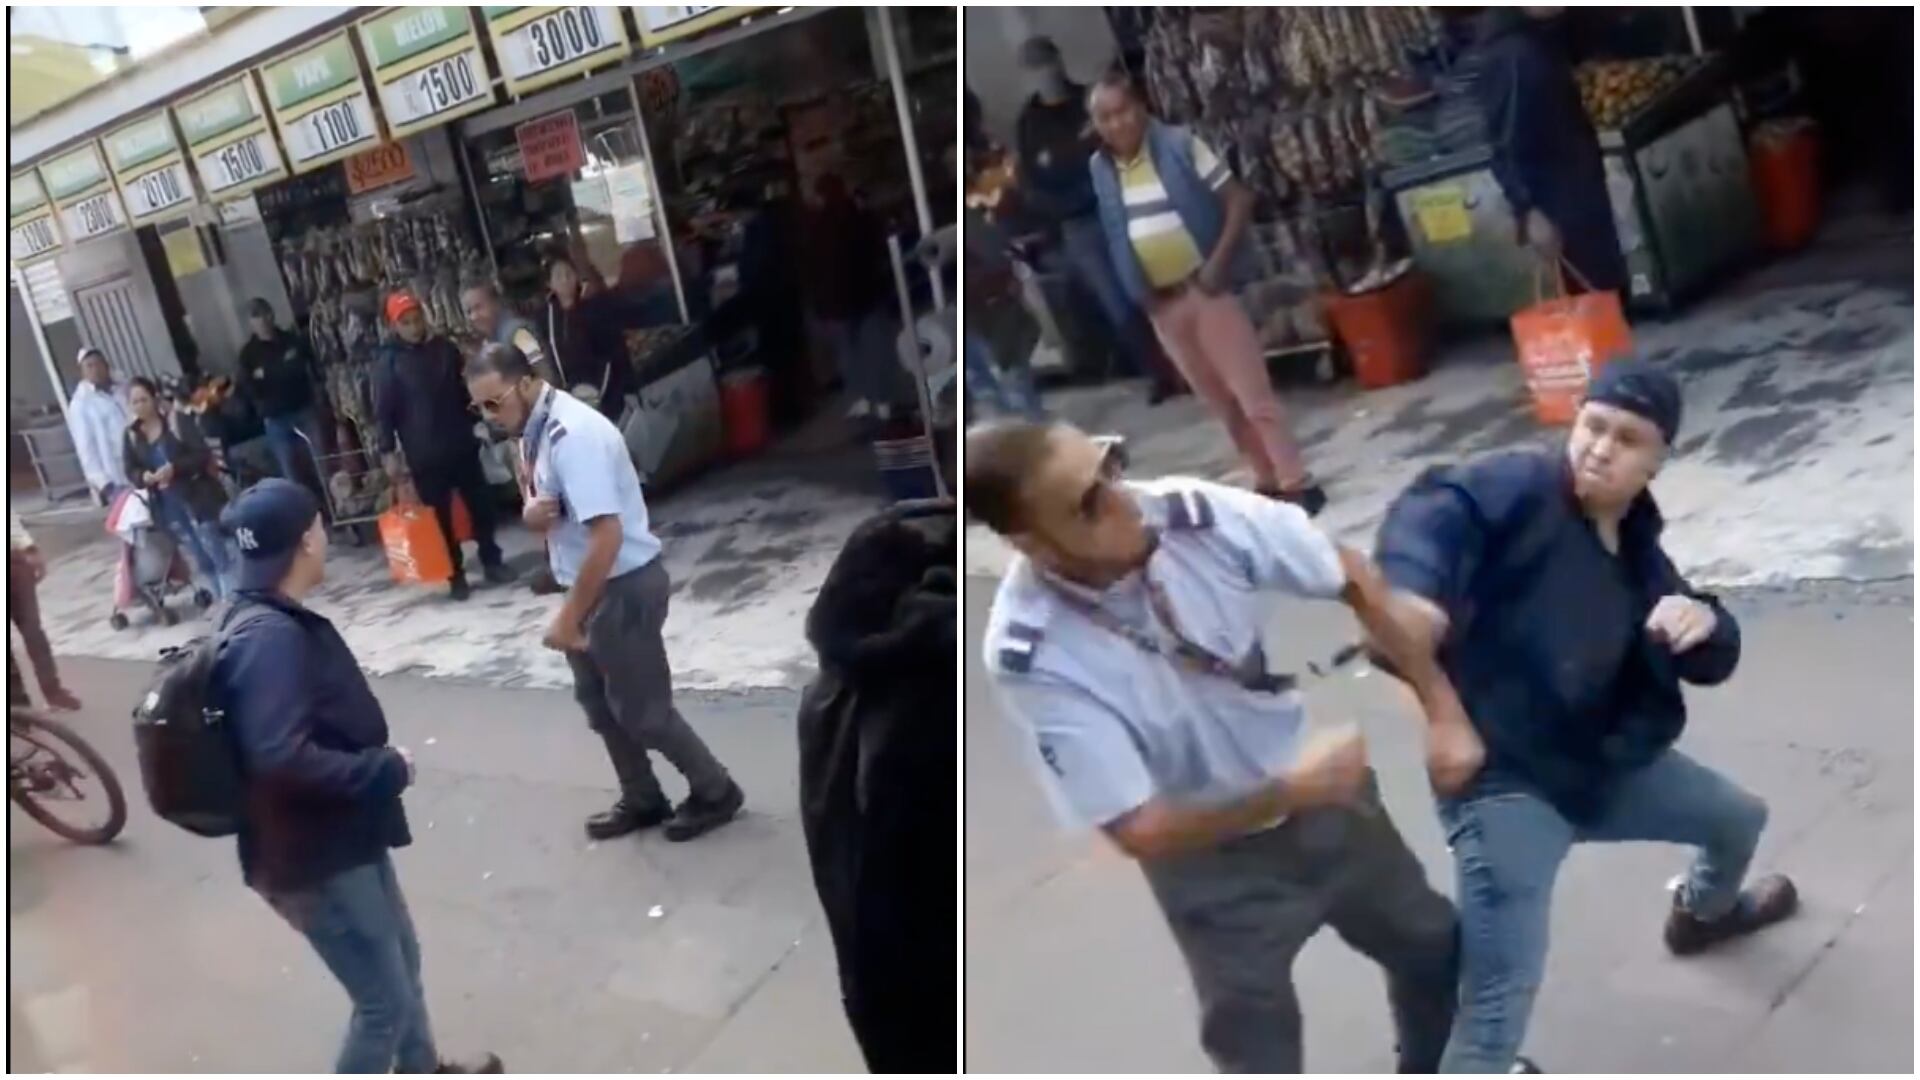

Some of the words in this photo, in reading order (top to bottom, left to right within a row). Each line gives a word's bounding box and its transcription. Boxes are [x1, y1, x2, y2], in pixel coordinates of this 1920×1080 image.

[531, 6, 600, 66] 3000
[420, 55, 474, 112] 1500
[312, 101, 359, 150] 1100
[221, 137, 264, 183] 1500
[236, 527, 259, 550] NY
